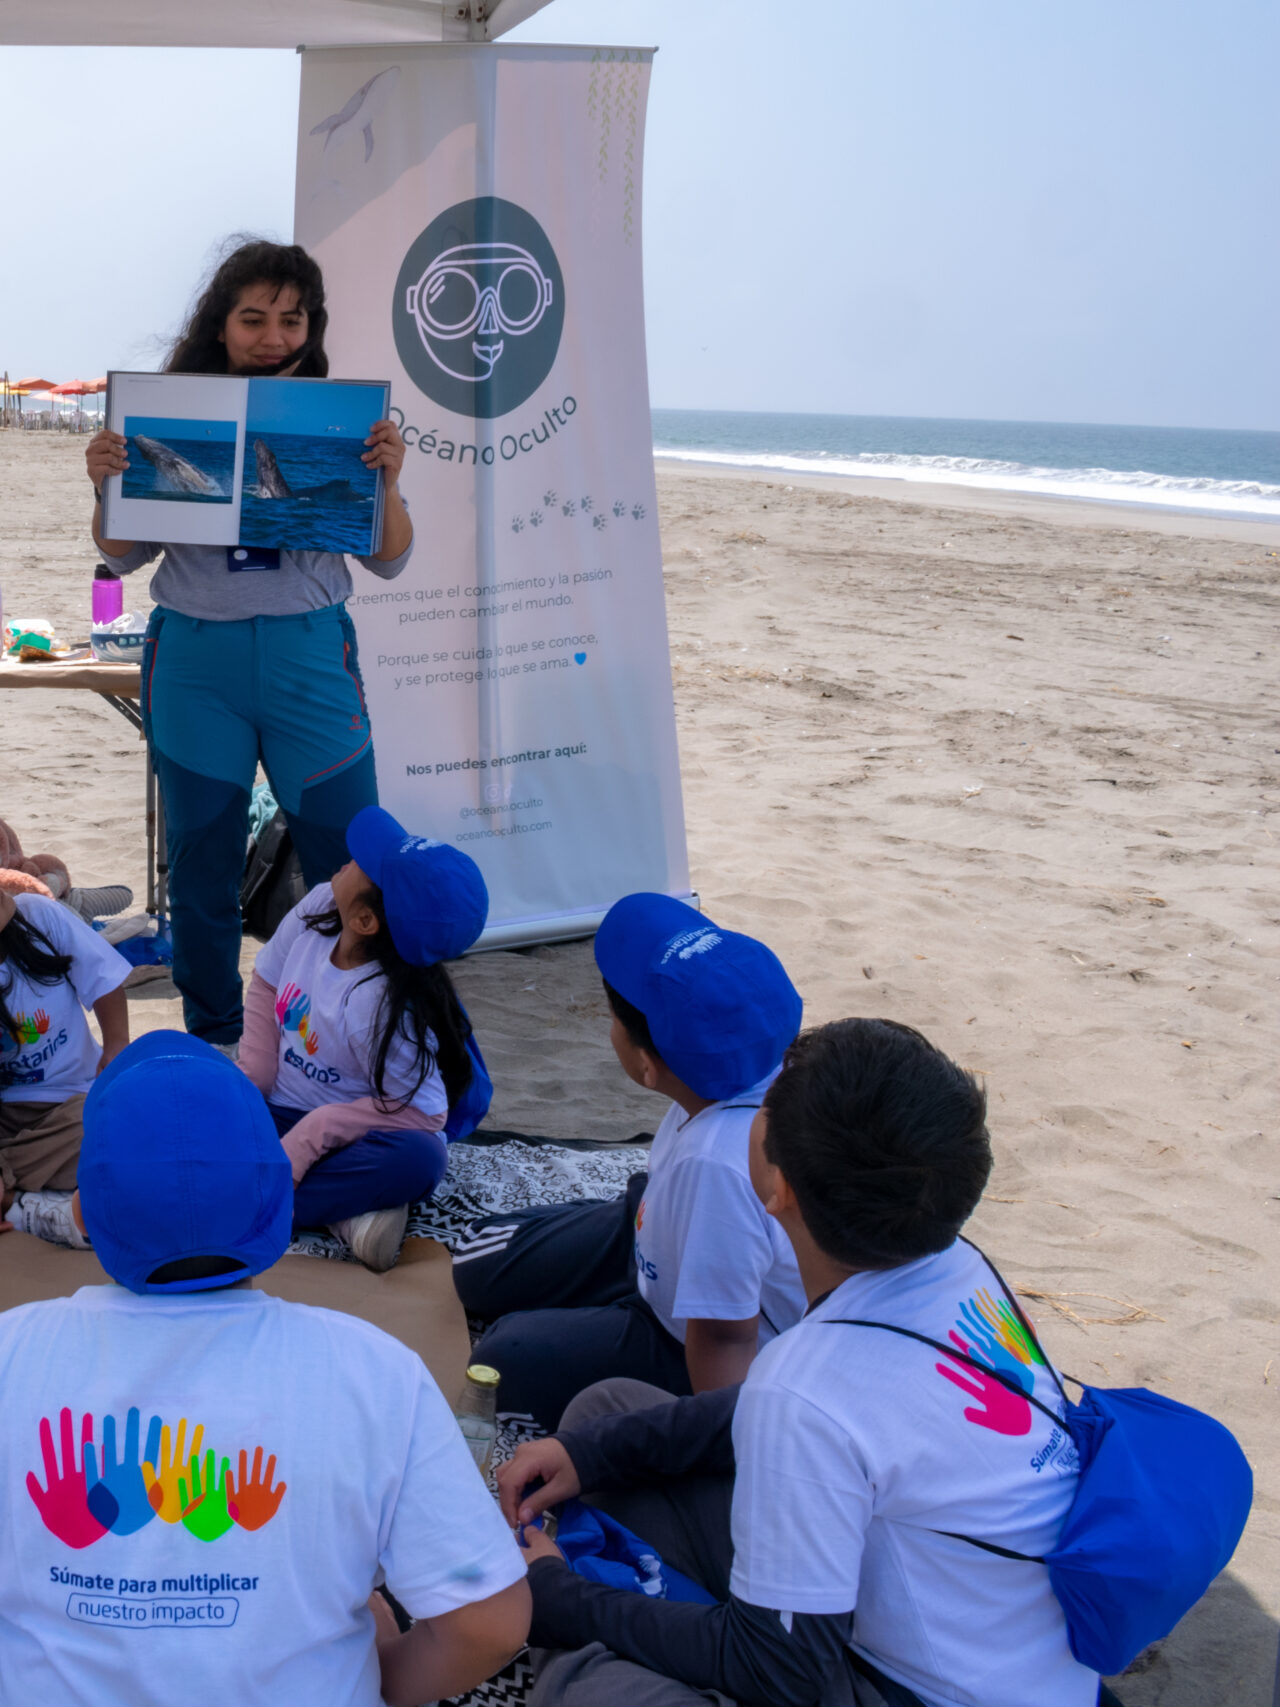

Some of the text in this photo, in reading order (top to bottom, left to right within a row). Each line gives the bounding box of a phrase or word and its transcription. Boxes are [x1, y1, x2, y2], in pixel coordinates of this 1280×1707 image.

[500, 396, 577, 460] Oculto
[347, 568, 613, 606] Creemos que el conocimiento y la pasión
[399, 593, 574, 625] pueden cambiar el mundo.
[377, 633, 599, 667] Porque se cuida lo que se conoce,
[393, 677, 402, 690] y
[405, 675, 421, 686] se
[425, 670, 484, 687] protege
[487, 667, 498, 680] lo
[499, 664, 520, 679] que
[523, 662, 537, 673] se
[406, 742, 587, 776] Nos puedes encontrar aquí:
[50, 1566, 259, 1595] Súmate para multiplicar
[78, 1601, 225, 1623] nuestro impacto
